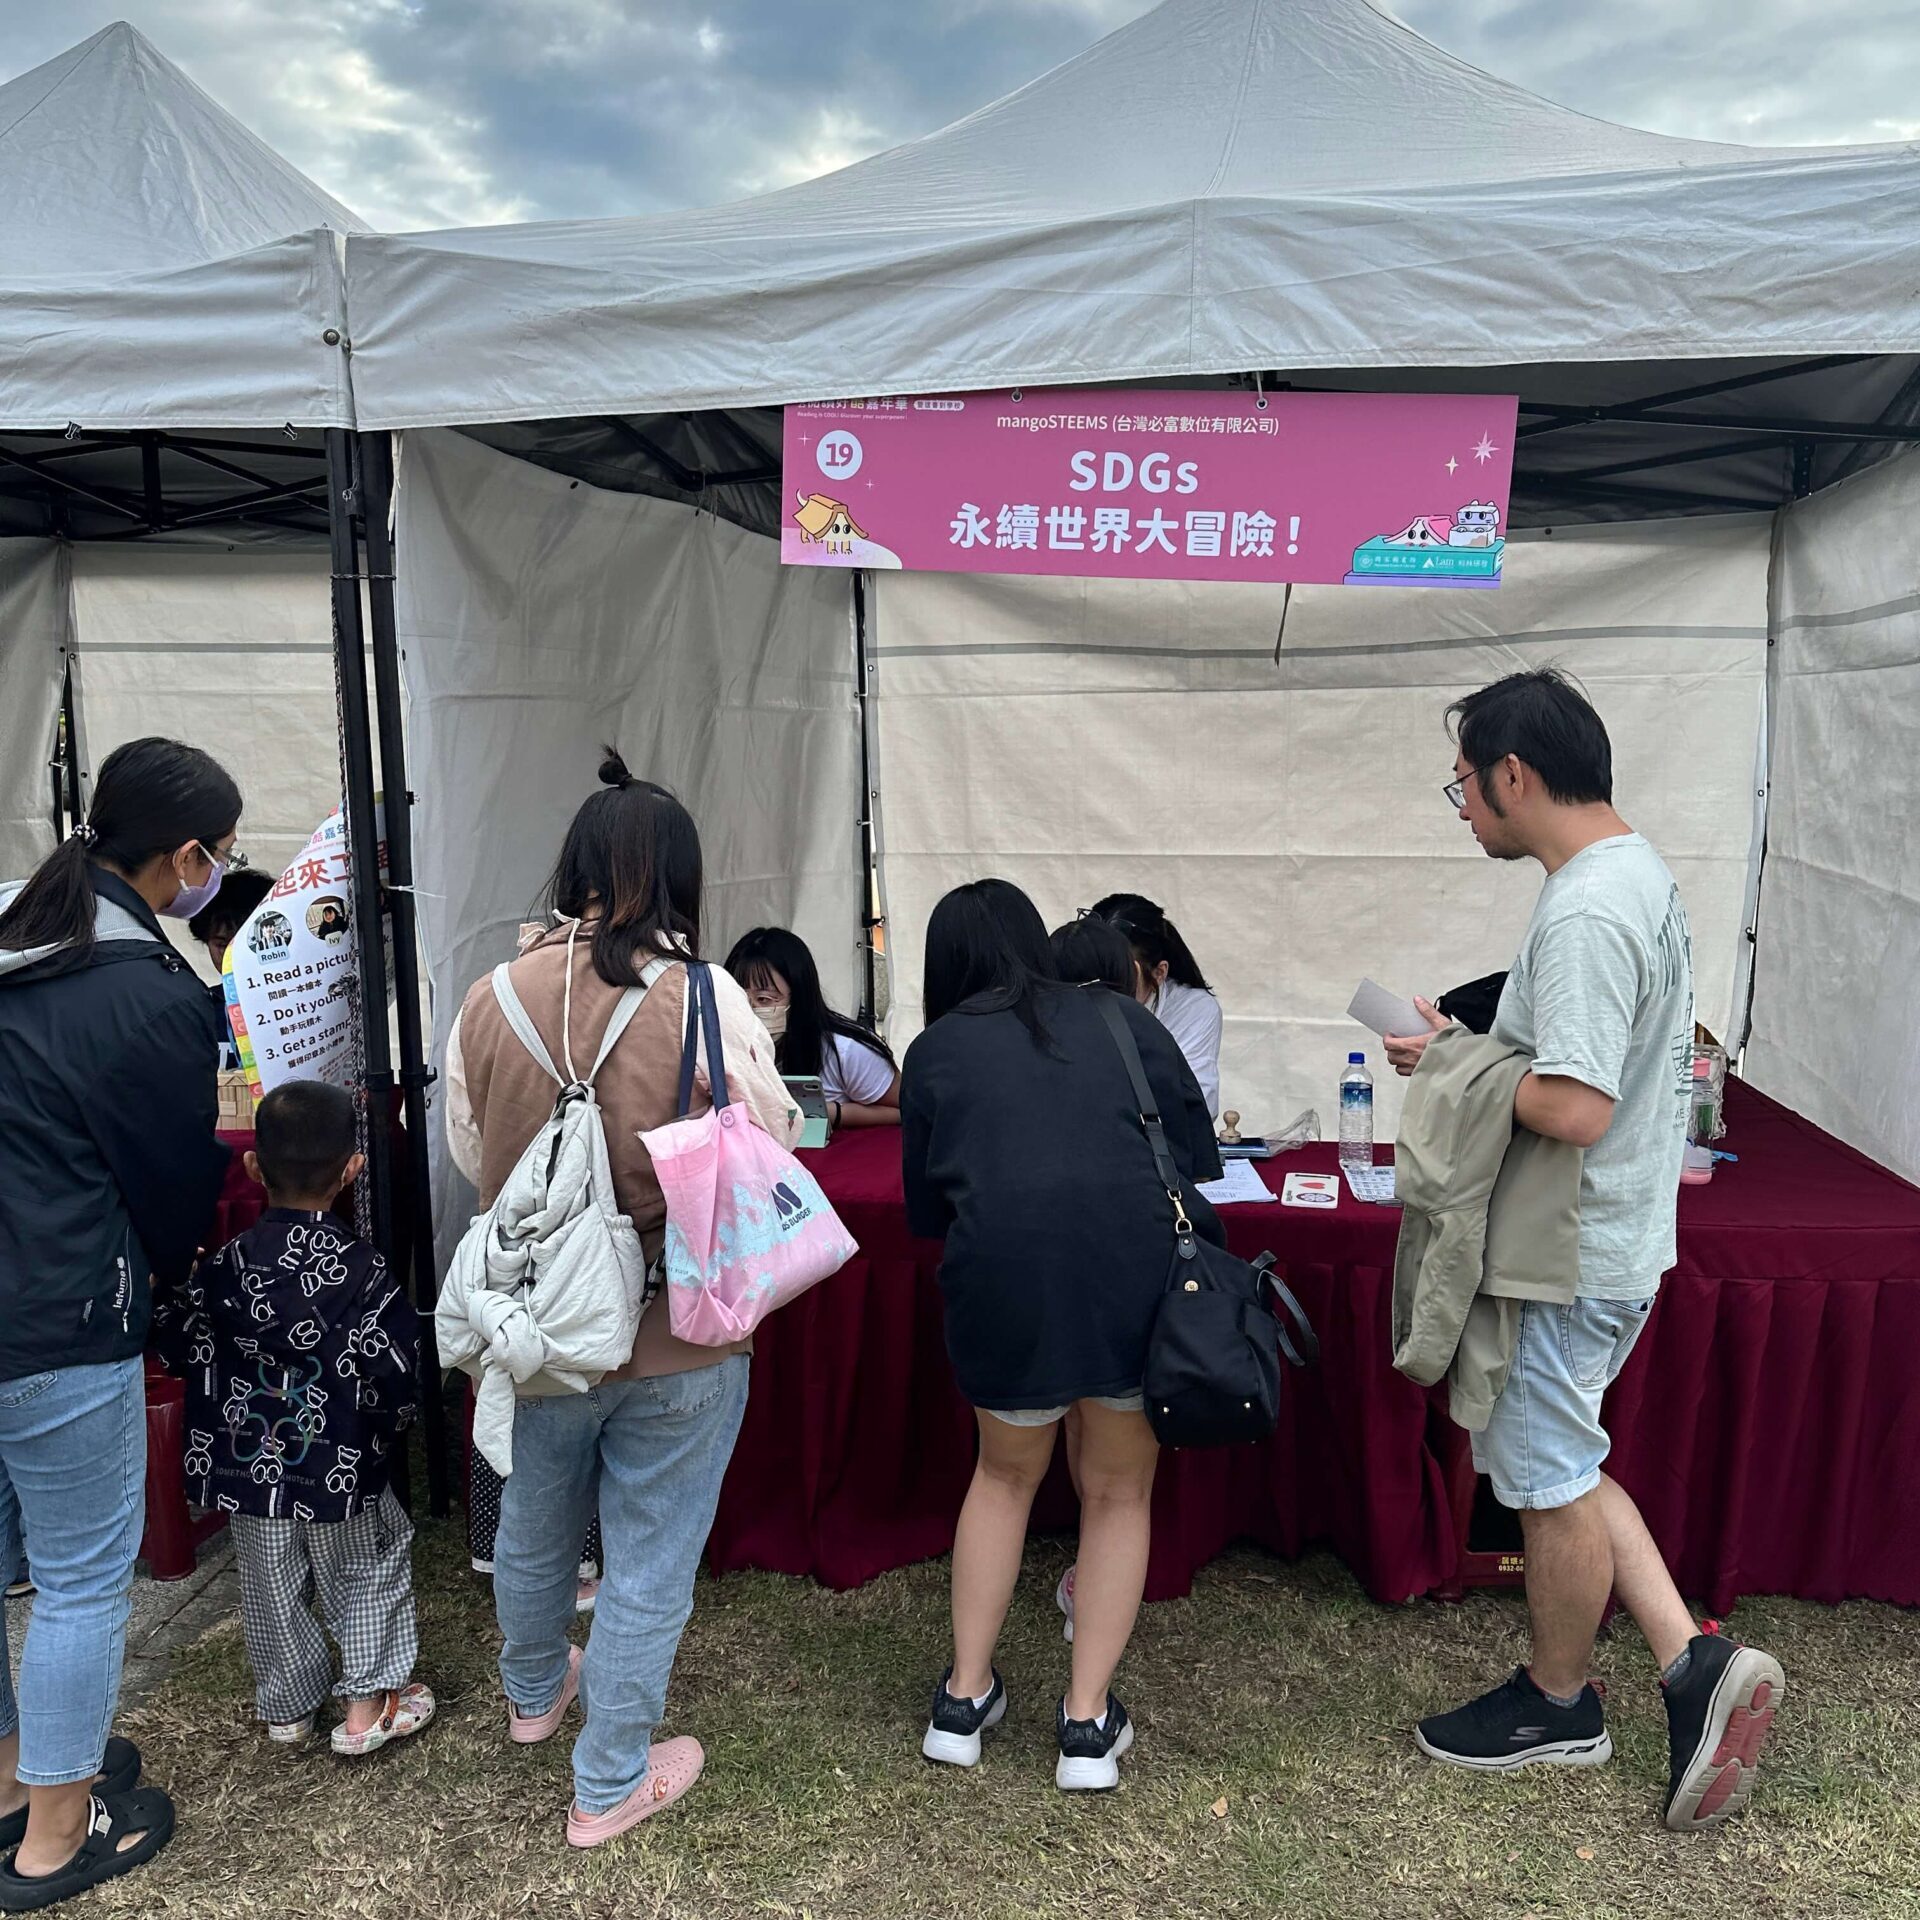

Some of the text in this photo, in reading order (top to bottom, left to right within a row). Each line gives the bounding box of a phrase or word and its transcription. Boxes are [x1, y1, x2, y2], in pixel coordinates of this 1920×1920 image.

[997, 414, 1279, 435] mangoSTEEMS (台灣必富數位有限公司)
[825, 443, 854, 467] 19
[1069, 450, 1199, 494] SDGs
[949, 502, 1301, 558] 永續世界大冒險!
[329, 936, 341, 945] Ivy
[261, 950, 287, 962] Robin
[247, 977, 261, 989] 1.
[264, 965, 301, 985] Read
[304, 964, 313, 975] a
[256, 1014, 271, 1026] 2.
[274, 1007, 293, 1021] Do
[296, 1001, 307, 1015] it
[280, 1015, 323, 1036] 動手玩積木
[265, 1048, 280, 1060] 3.
[283, 1037, 308, 1054] Get
[309, 1036, 316, 1046] a
[788, 1207, 812, 1227] BURGER
